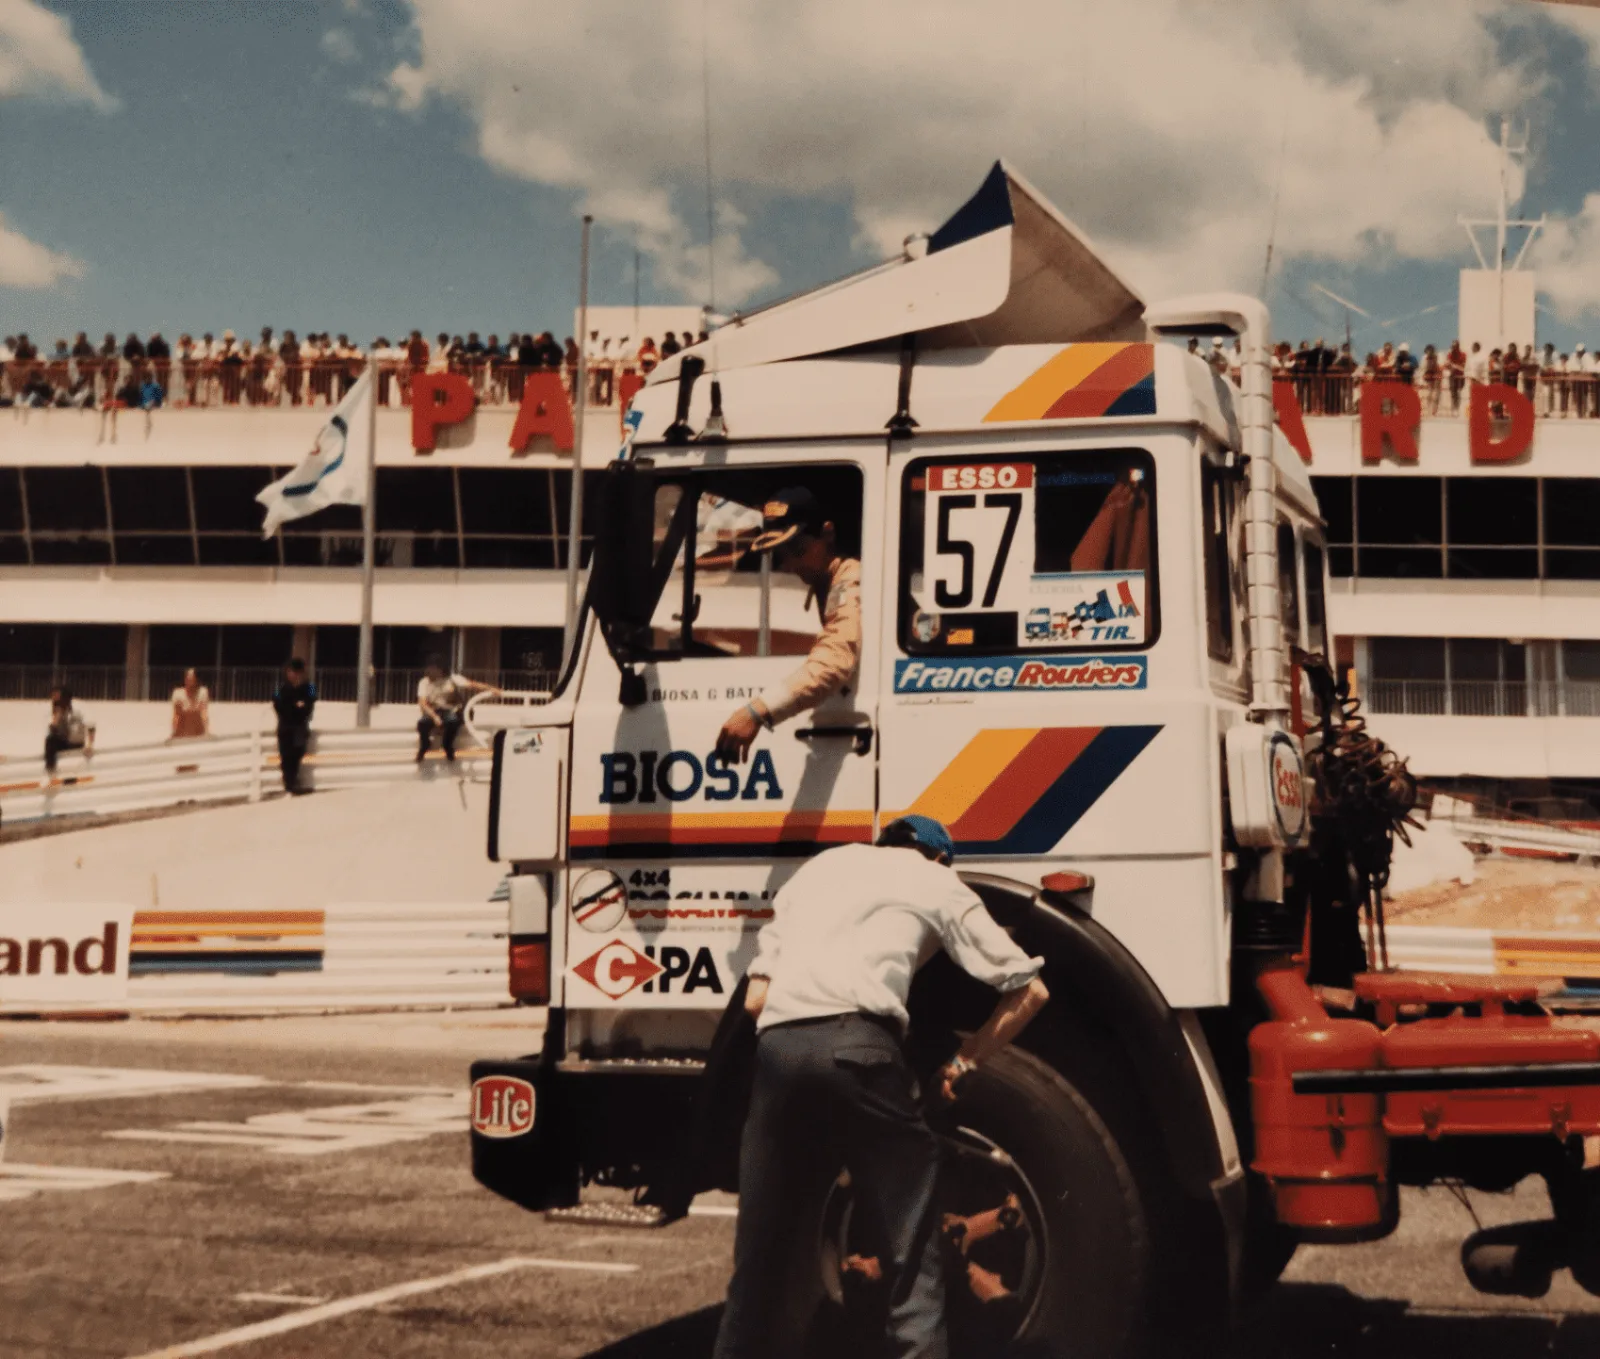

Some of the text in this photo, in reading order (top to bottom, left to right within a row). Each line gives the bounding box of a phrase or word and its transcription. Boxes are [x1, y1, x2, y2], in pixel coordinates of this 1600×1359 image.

[941, 466, 1018, 489] ESSO
[934, 493, 1023, 608] 57
[1088, 625, 1130, 641] TIR
[899, 659, 1142, 689] France Routiers
[599, 750, 784, 803] BIOSA
[629, 869, 671, 887] 4x4
[0, 921, 119, 976] and
[593, 941, 724, 998] CIPA
[475, 1086, 530, 1128] Life
